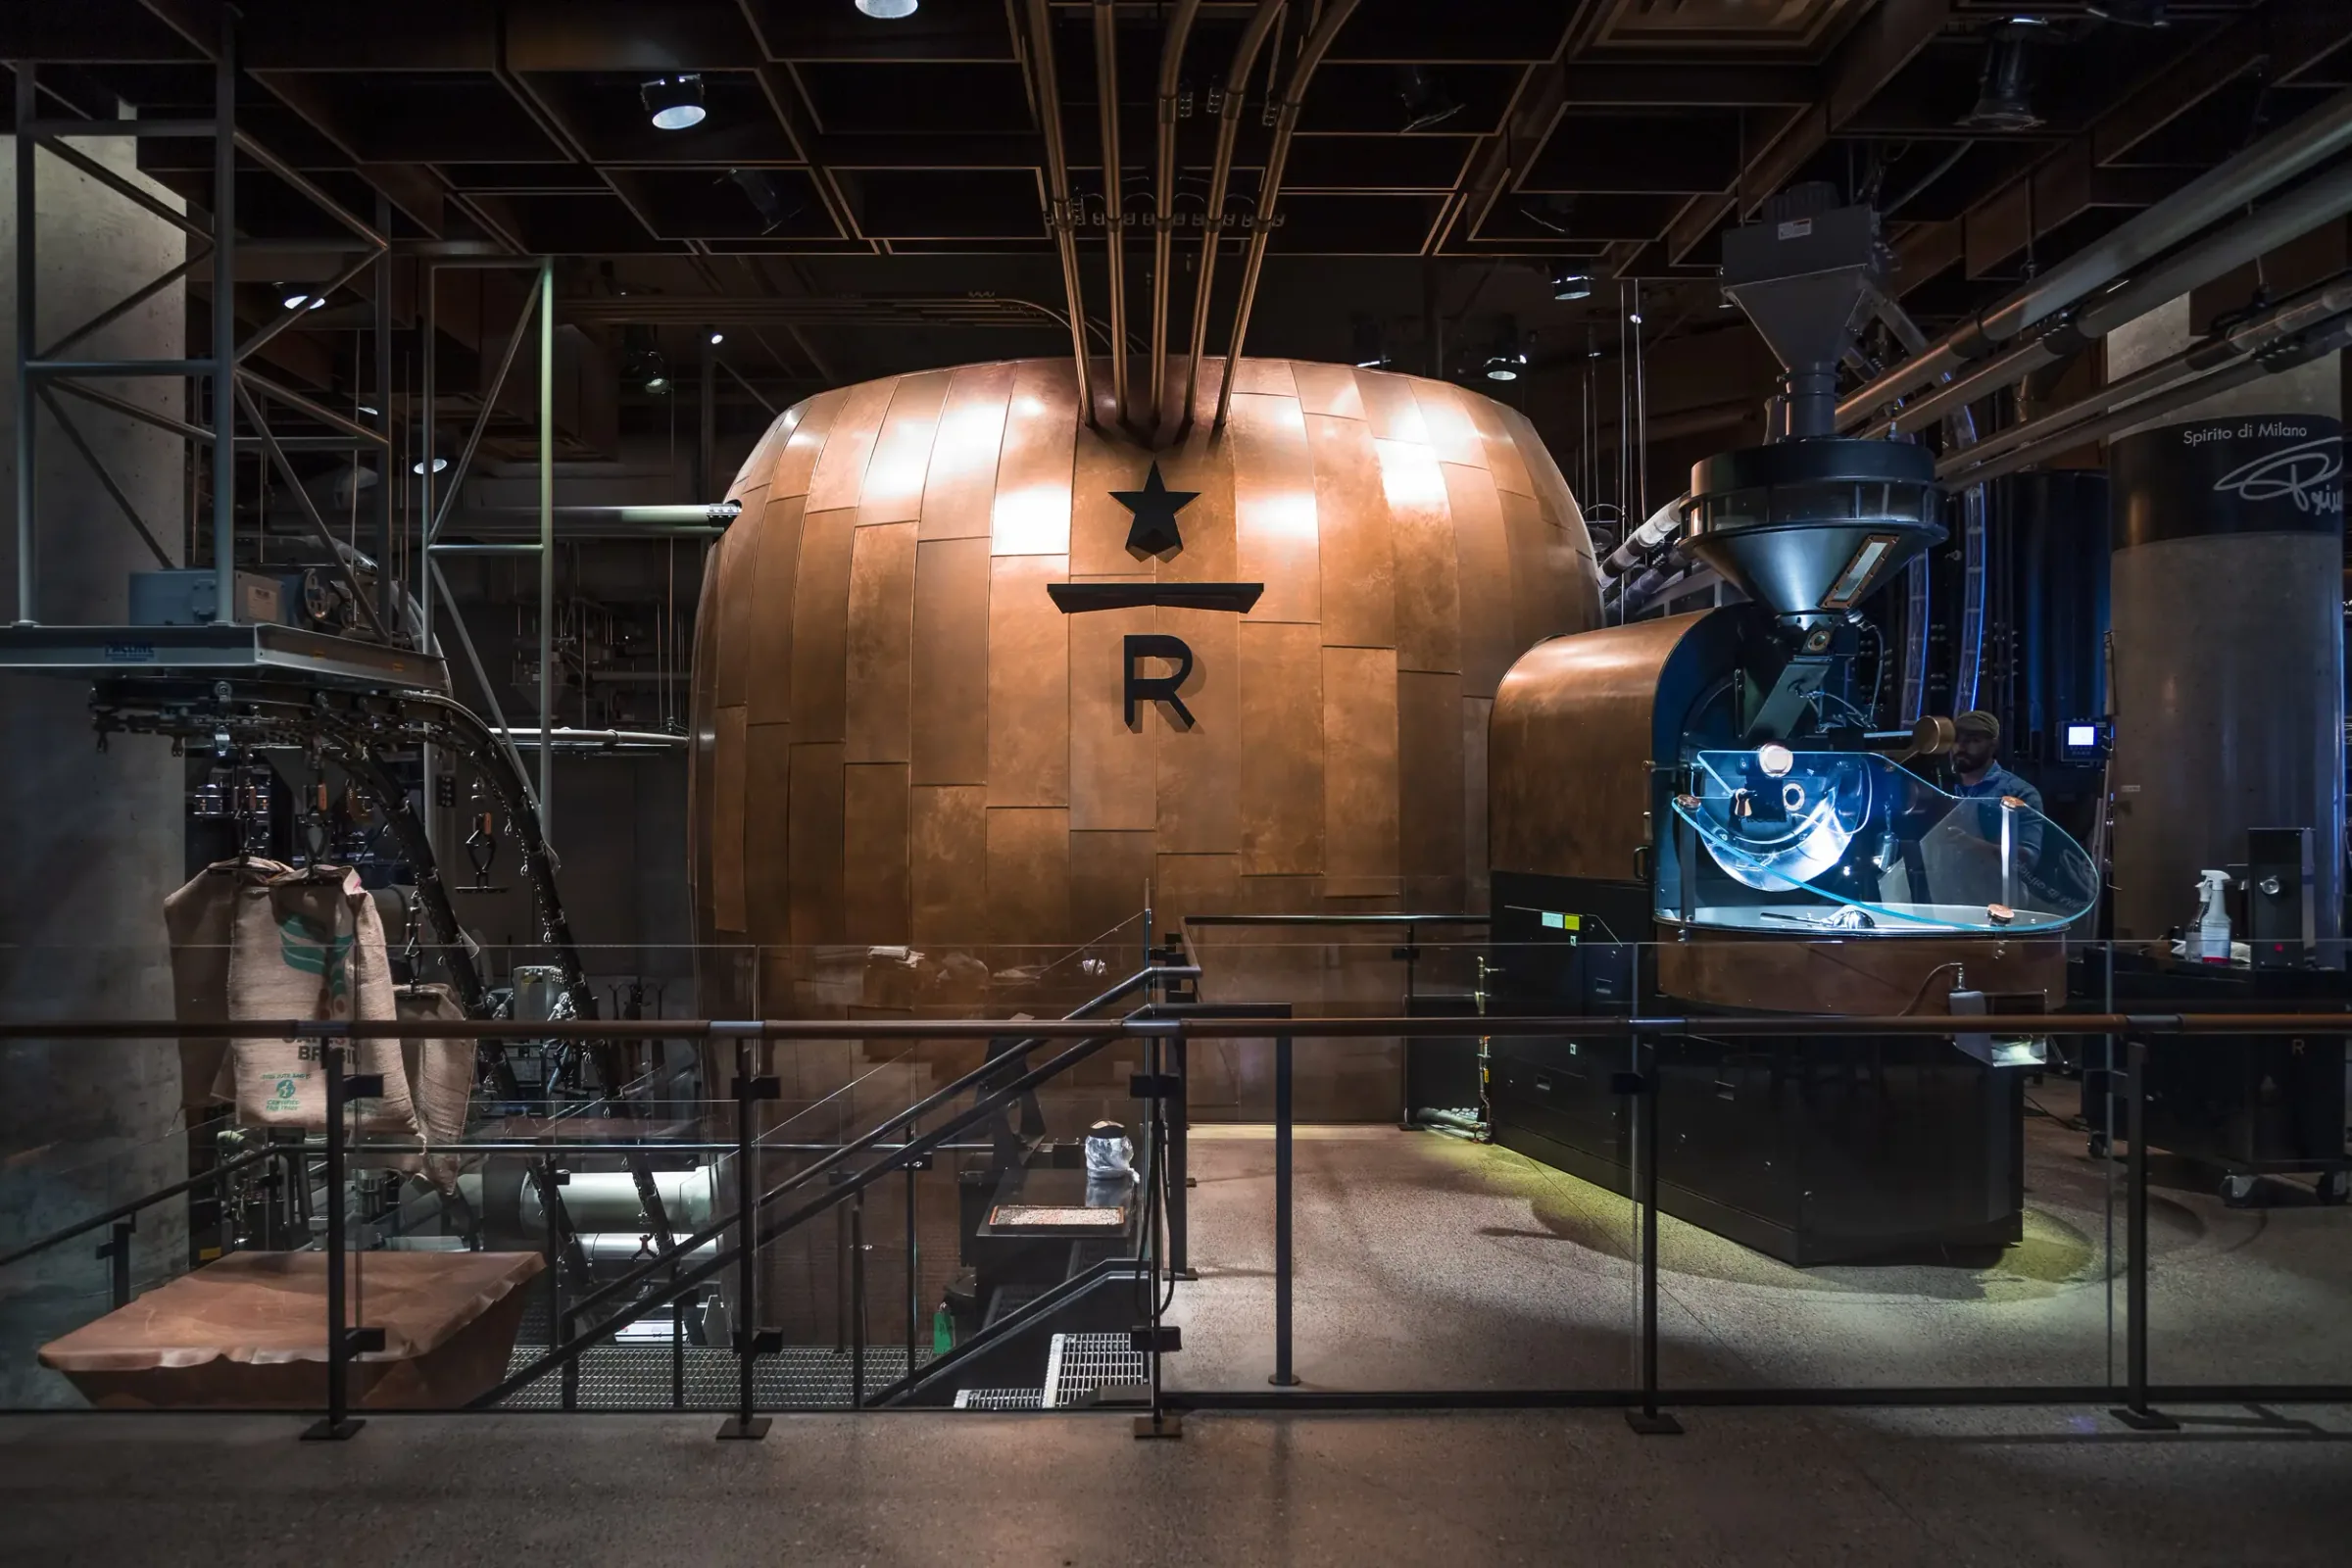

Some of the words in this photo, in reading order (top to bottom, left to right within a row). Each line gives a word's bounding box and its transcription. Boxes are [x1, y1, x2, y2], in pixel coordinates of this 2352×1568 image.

[2183, 427, 2232, 447] Spirito
[2237, 423, 2253, 438] di
[2258, 421, 2307, 438] Milano
[1123, 634, 1196, 732] R
[2291, 1039, 2306, 1055] R
